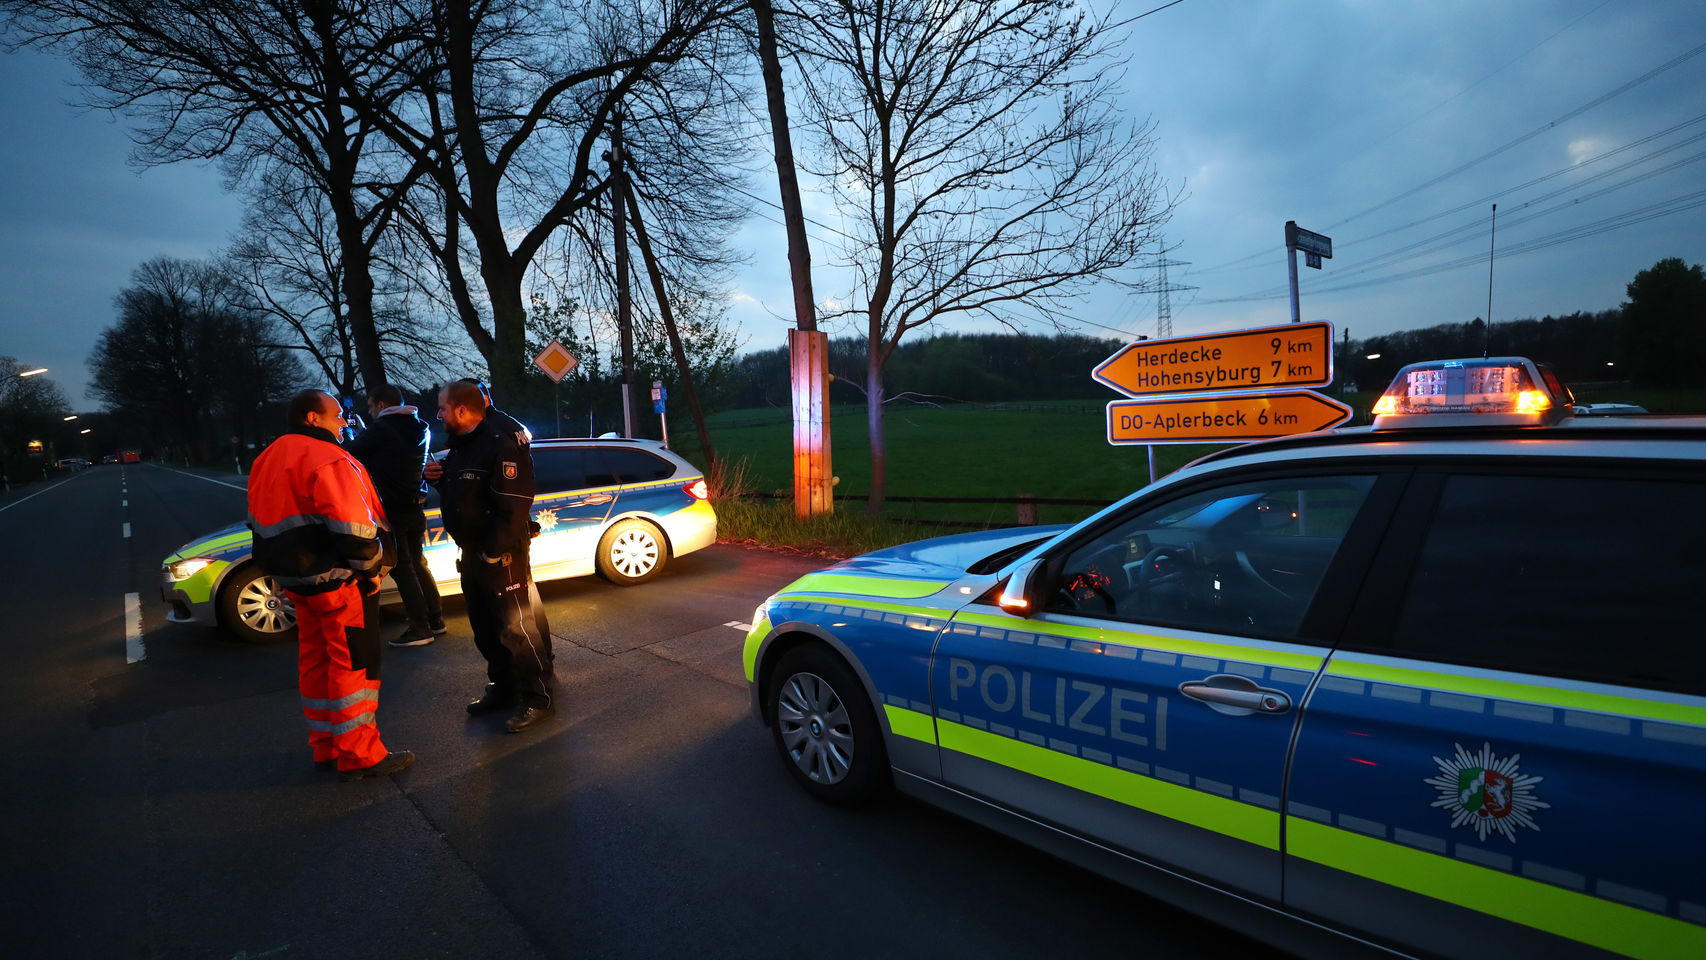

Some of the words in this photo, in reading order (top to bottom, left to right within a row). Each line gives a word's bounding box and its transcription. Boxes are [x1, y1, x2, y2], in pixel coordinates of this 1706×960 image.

[1137, 345, 1222, 367] Herdecke
[1271, 338, 1281, 355] 9
[1288, 341, 1312, 353] km
[1138, 366, 1261, 387] Hohensyburg
[1271, 361, 1282, 378] 7
[1288, 364, 1312, 376] km
[1121, 410, 1247, 432] DO-Aplerbeck
[1258, 409, 1268, 425] 6
[1274, 412, 1298, 425] km
[950, 657, 1168, 751] POLIZEI
